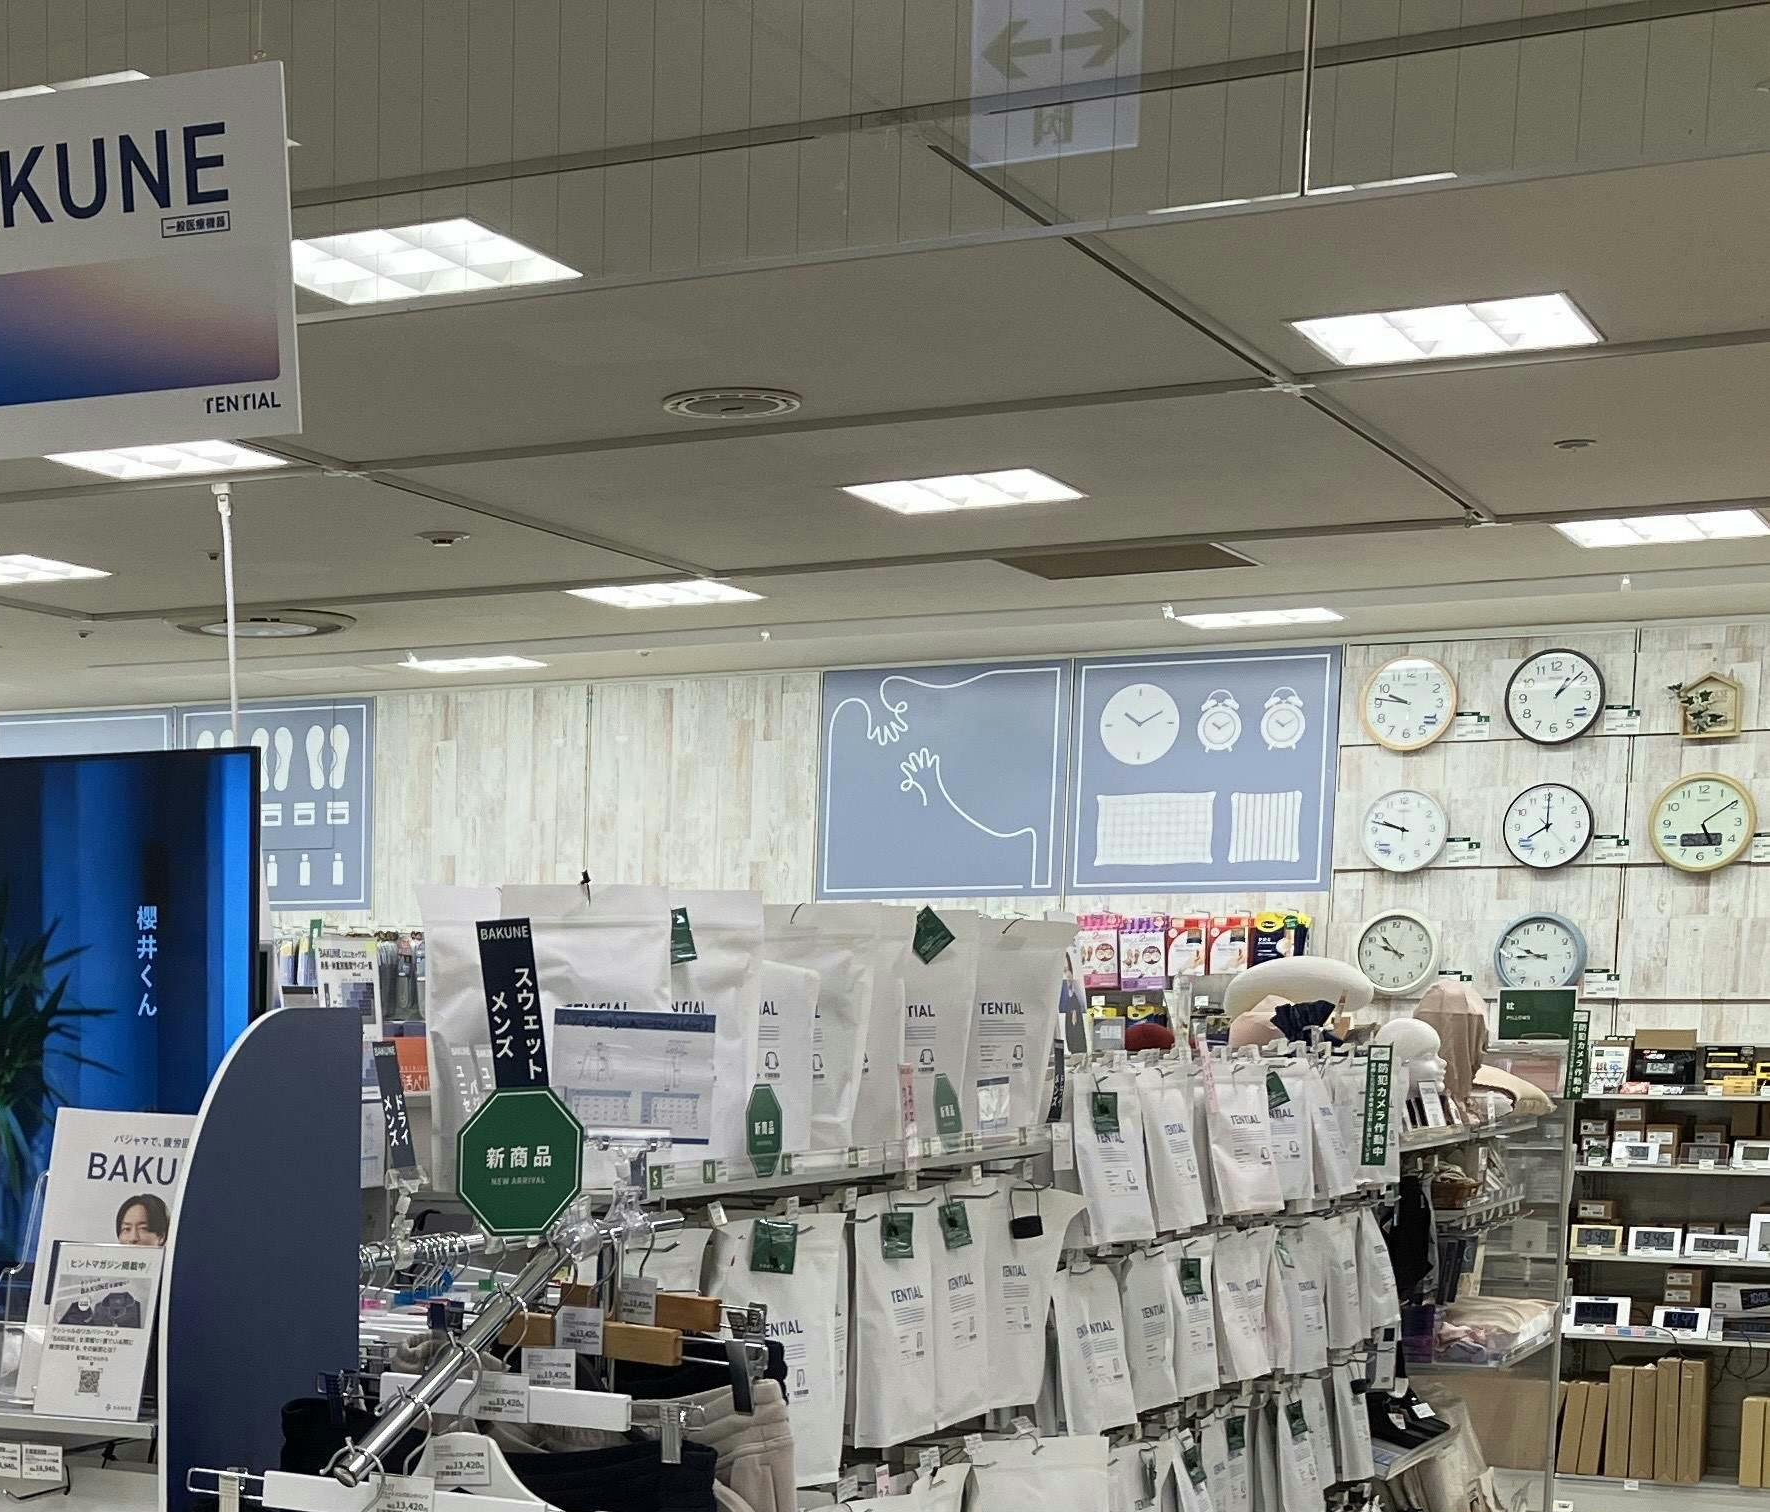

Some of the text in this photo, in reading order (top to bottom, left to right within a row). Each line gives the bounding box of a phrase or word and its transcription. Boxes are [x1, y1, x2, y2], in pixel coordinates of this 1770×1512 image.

[165, 214, 228, 236] 一般医療機器
[205, 392, 282, 415] TENTIAL
[480, 925, 529, 941] BAKUNE
[136, 905, 159, 1018] 櫻井くん
[978, 1001, 1025, 1016] TENTIAL
[491, 992, 514, 1059] メンズ
[514, 967, 542, 1080] スウェット
[394, 1095, 410, 1145] ドライ
[1373, 1062, 1389, 1157] 防犯カメラ作動中
[382, 1096, 399, 1148] メンズ
[87, 1152, 178, 1185] BAKU
[486, 1145, 552, 1170] 新商品
[490, 1176, 546, 1186] NEW ARRIVAL
[651, 1169, 659, 1185] S
[70, 1258, 147, 1272] ヒントマガジン掲載中
[765, 1319, 803, 1335] ENTIAL
